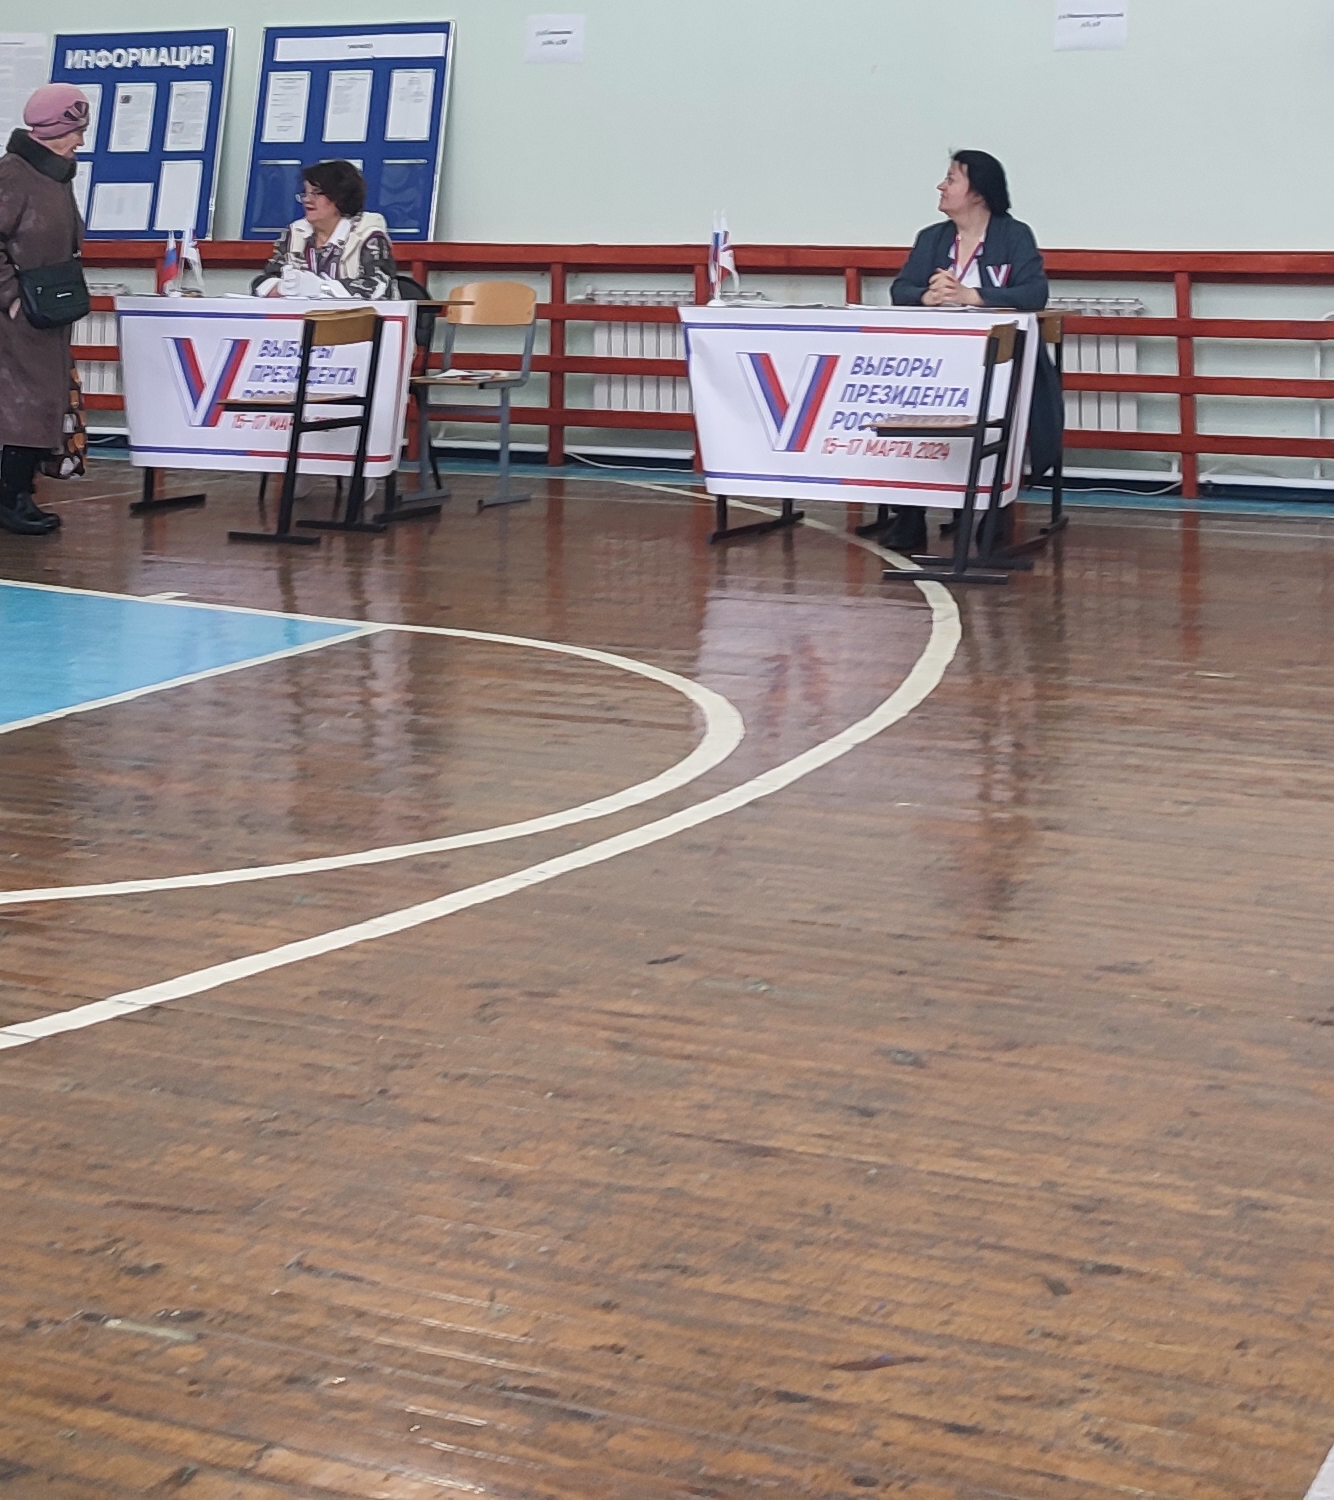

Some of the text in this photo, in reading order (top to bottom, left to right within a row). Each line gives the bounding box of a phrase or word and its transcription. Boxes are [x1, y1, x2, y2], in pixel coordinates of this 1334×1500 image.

[64, 44, 215, 70] ИНФОРМАЦИЯ
[850, 355, 944, 378] ВЫБОРЫ
[838, 383, 970, 408] ПРЕЗИДЕНТА
[828, 410, 886, 432] РОСС
[862, 439, 914, 458] МАРТА
[913, 441, 950, 460] 2024
